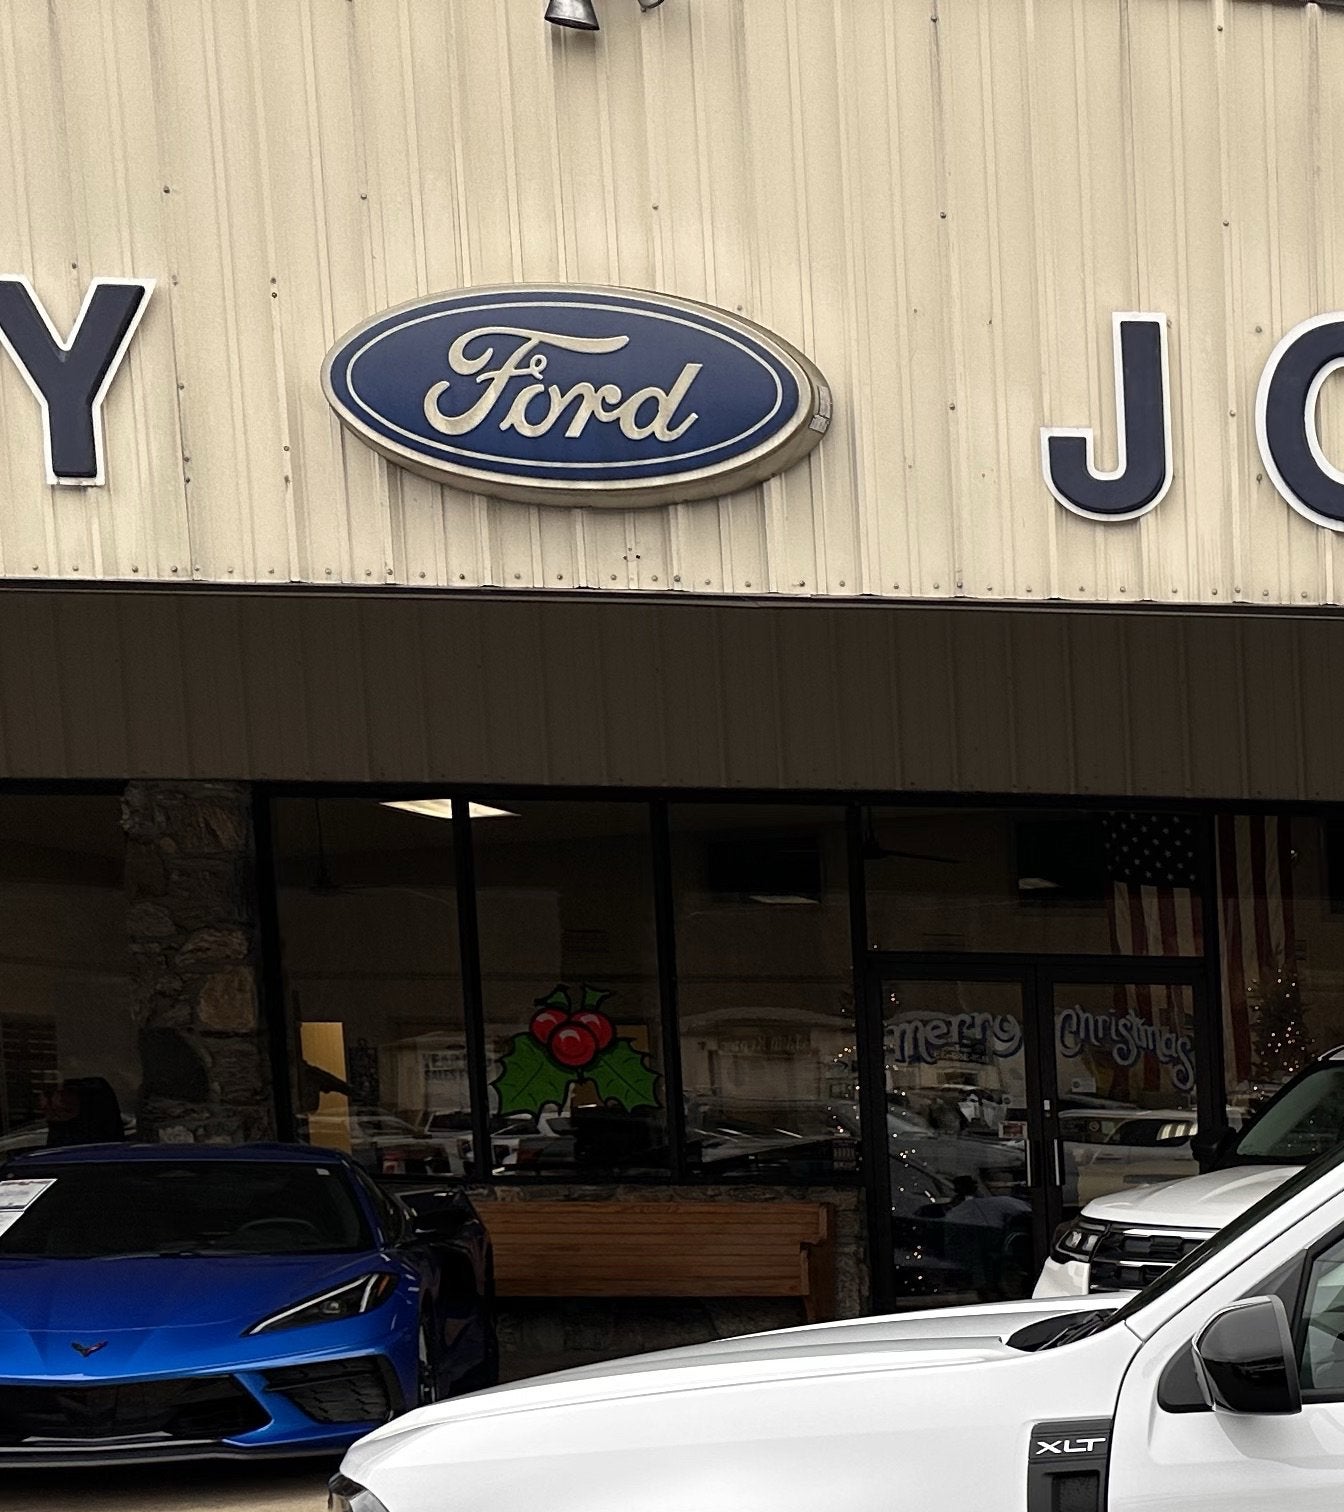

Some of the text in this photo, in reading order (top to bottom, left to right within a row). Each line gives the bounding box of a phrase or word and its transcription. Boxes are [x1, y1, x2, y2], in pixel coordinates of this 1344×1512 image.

[422, 325, 704, 443] Ford
[1056, 1003, 1195, 1091] Christmas
[1035, 1437, 1107, 1455] XLT
